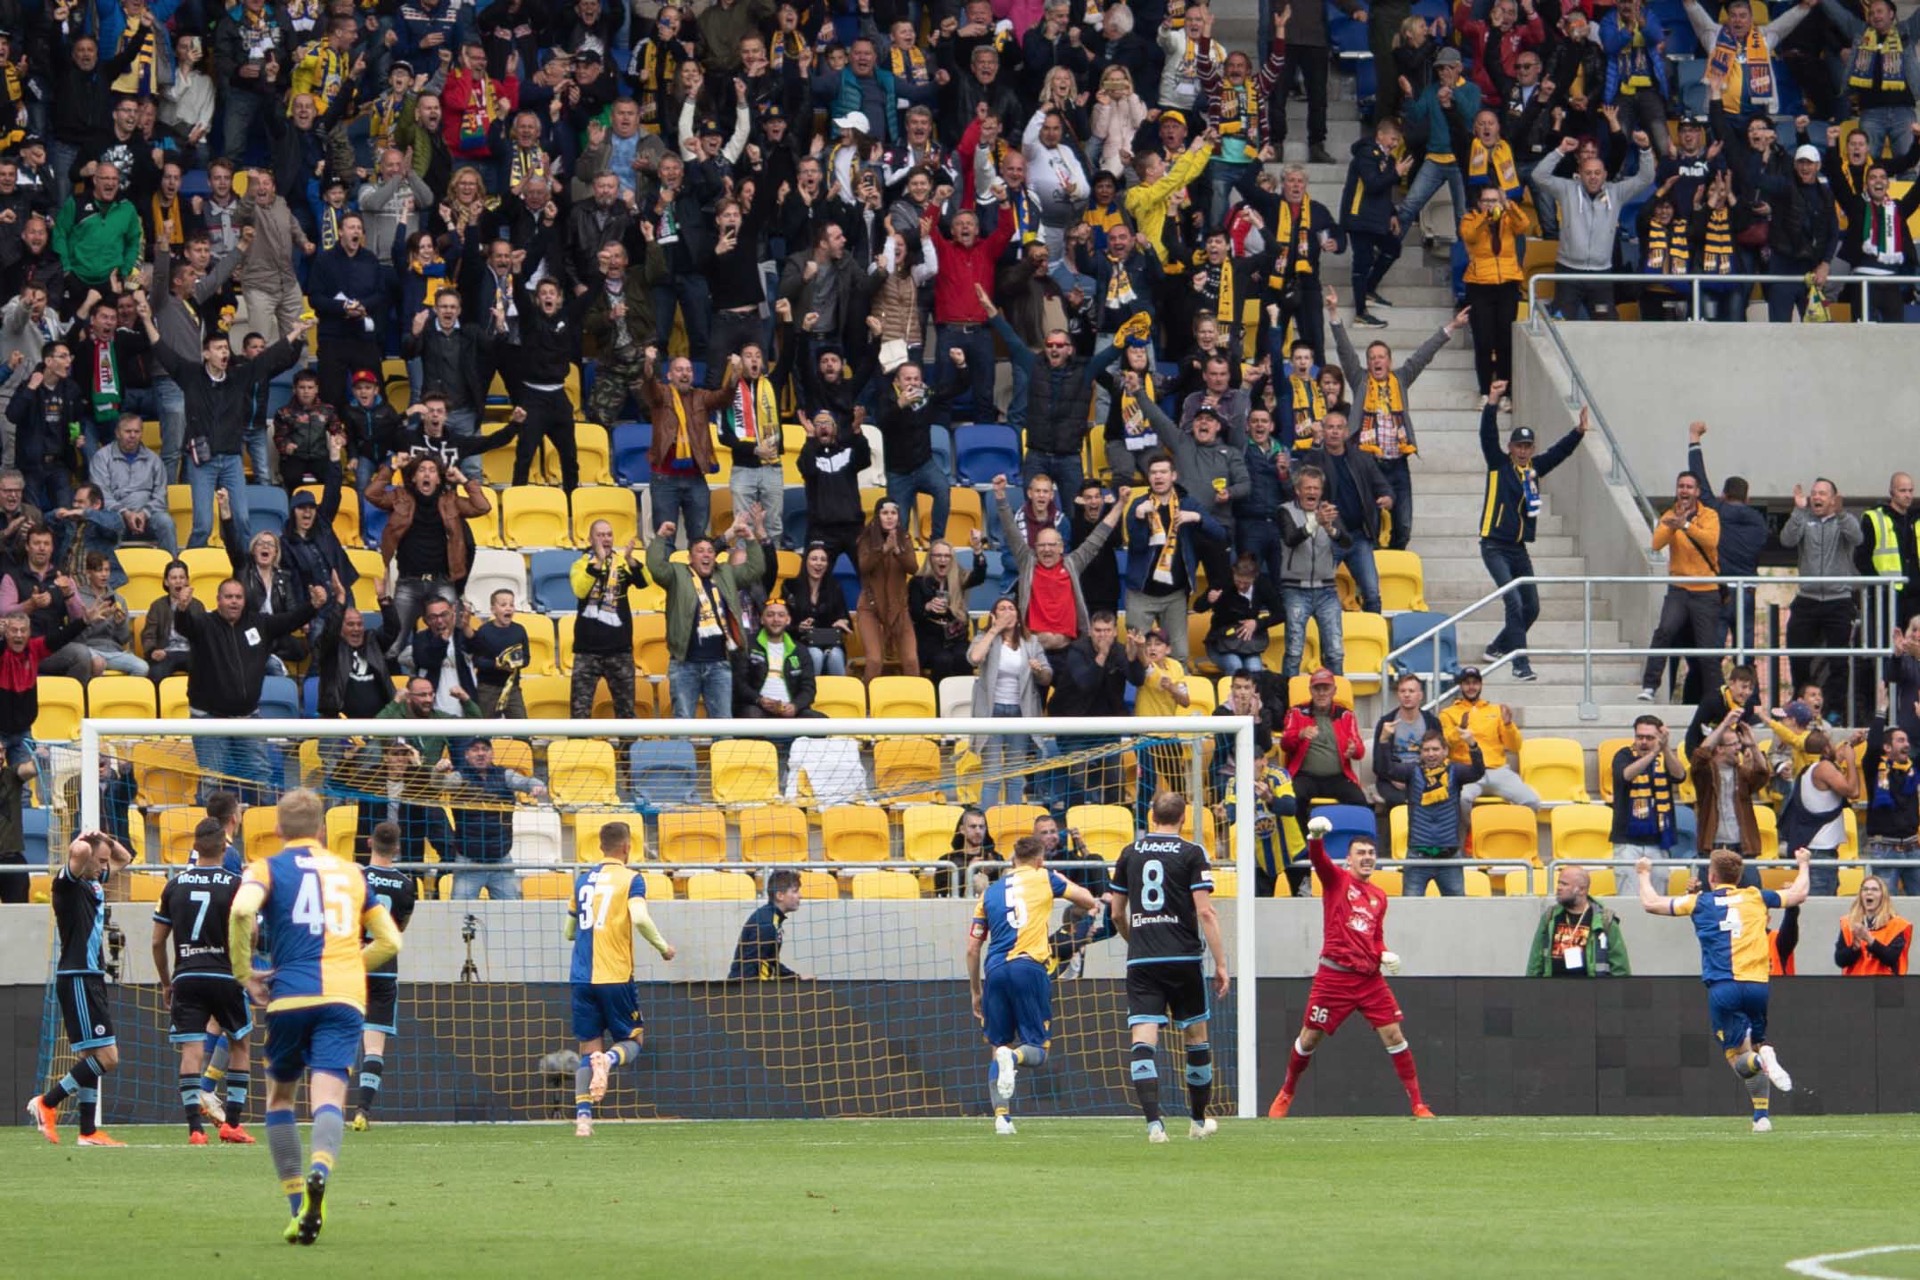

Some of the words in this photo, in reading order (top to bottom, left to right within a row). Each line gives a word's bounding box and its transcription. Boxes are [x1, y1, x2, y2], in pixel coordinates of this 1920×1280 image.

[1134, 841, 1181, 853] Ljubičić
[292, 873, 352, 937] 45
[1005, 885, 1028, 929] 5
[1141, 859, 1165, 911] 8
[190, 890, 211, 941] 7
[578, 885, 613, 930] 37
[1719, 907, 1742, 938] 4
[1309, 1005, 1329, 1024] 36
